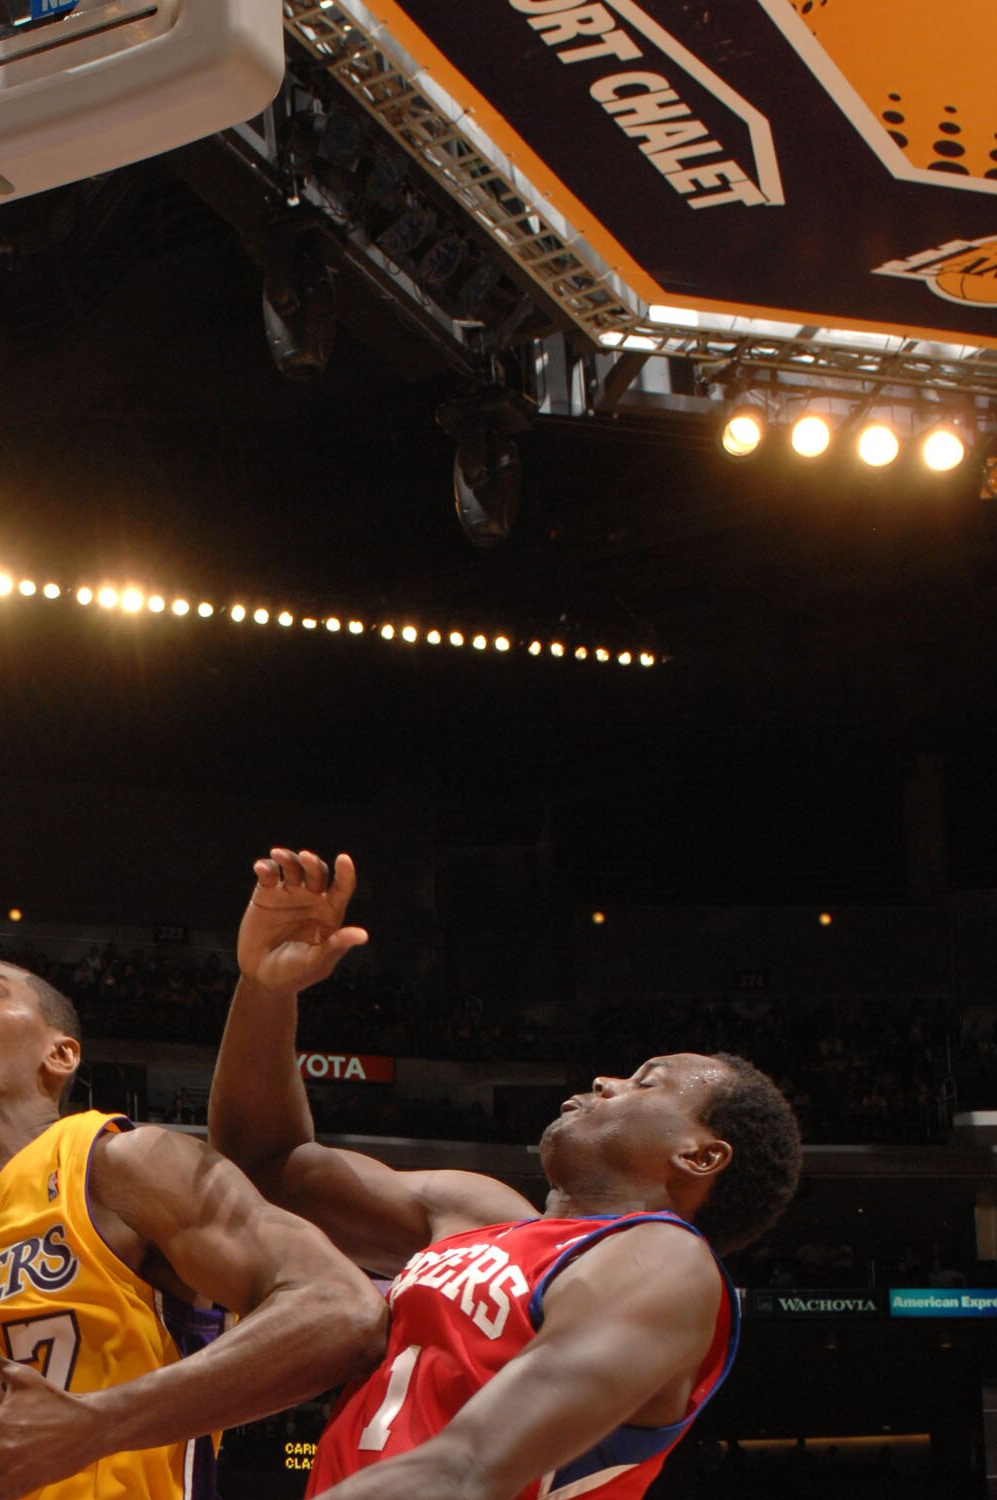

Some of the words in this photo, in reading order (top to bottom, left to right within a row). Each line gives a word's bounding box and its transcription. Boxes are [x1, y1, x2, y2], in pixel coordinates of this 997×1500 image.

[588, 71, 770, 210] CHALET
[778, 1298, 877, 1312] WACHOVIA
[892, 1295, 956, 1309] American
[358, 1345, 422, 1451] 1
